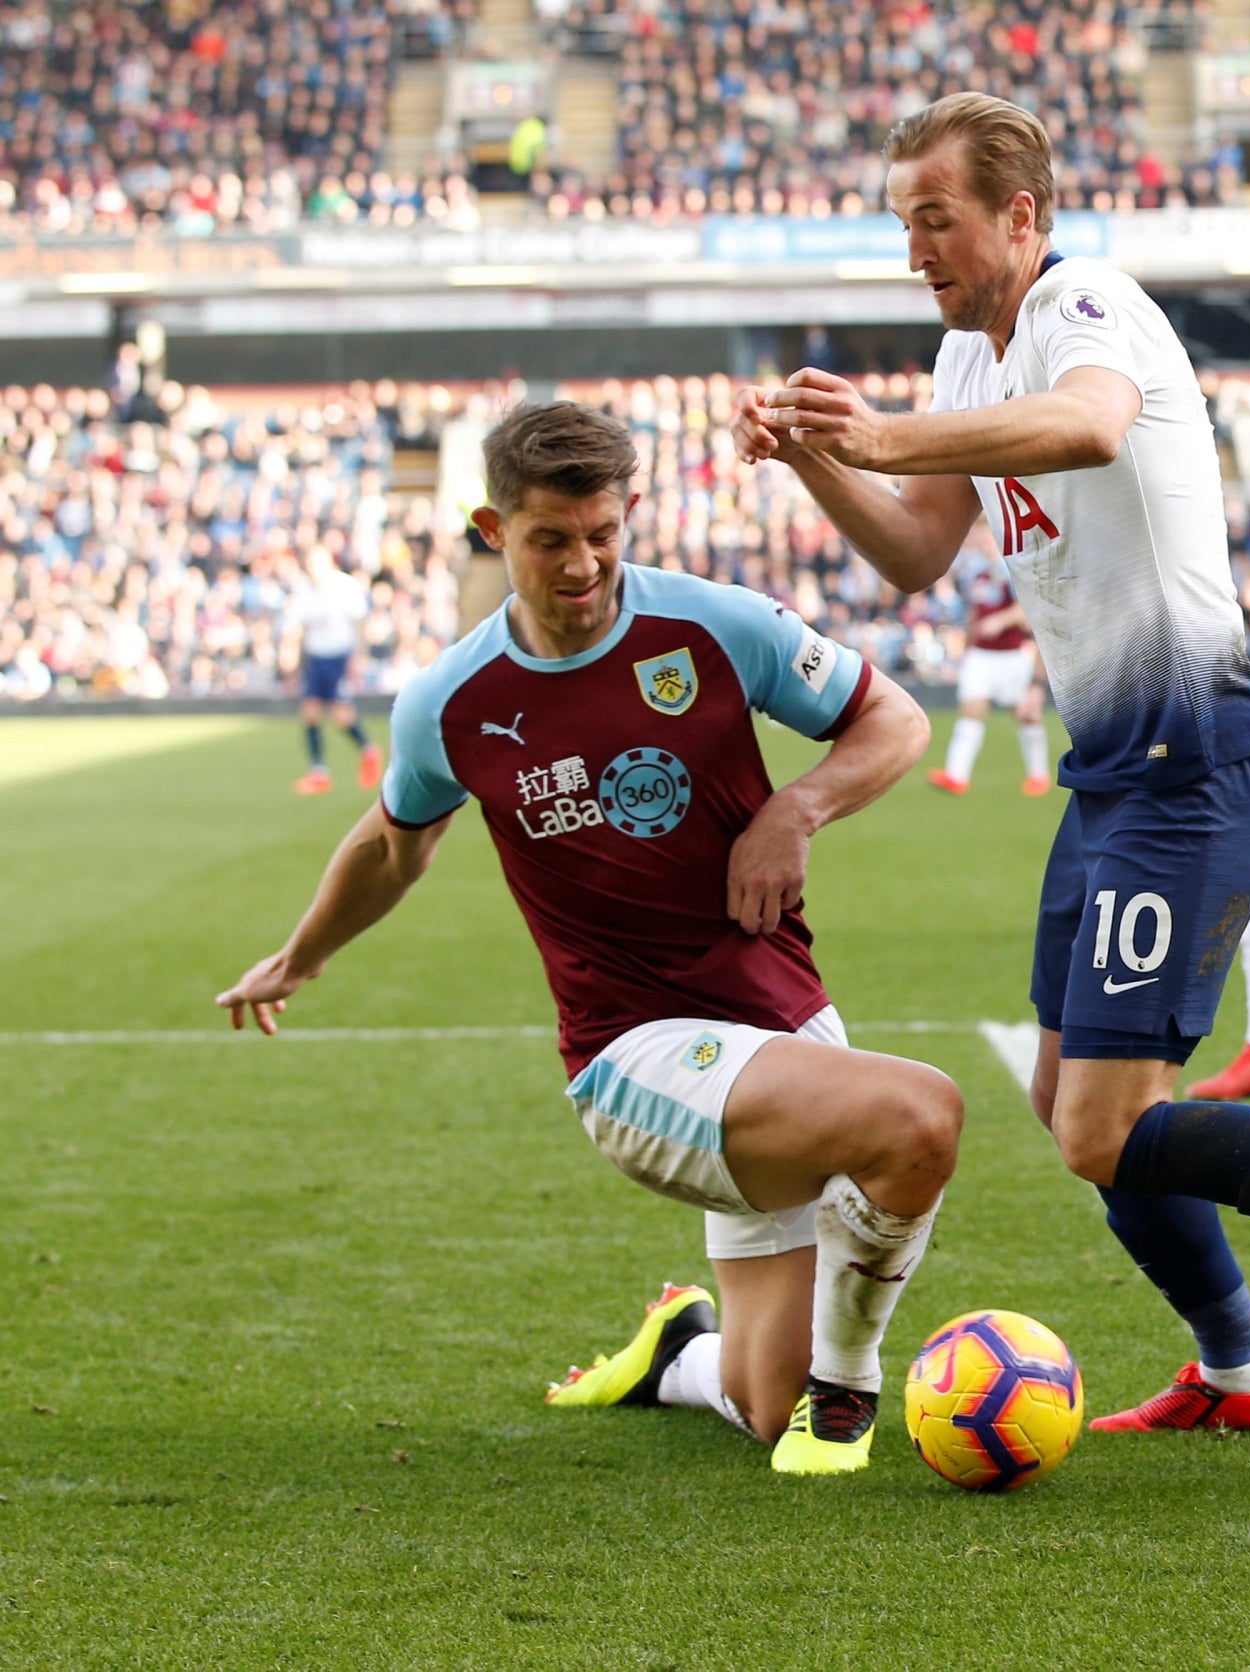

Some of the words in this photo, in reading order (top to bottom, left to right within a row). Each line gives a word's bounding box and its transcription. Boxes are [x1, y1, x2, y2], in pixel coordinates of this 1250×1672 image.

[516, 755, 590, 805] 拉霸
[622, 778, 669, 808] 360
[516, 797, 604, 839] LaBa
[1093, 890, 1172, 973] 10
